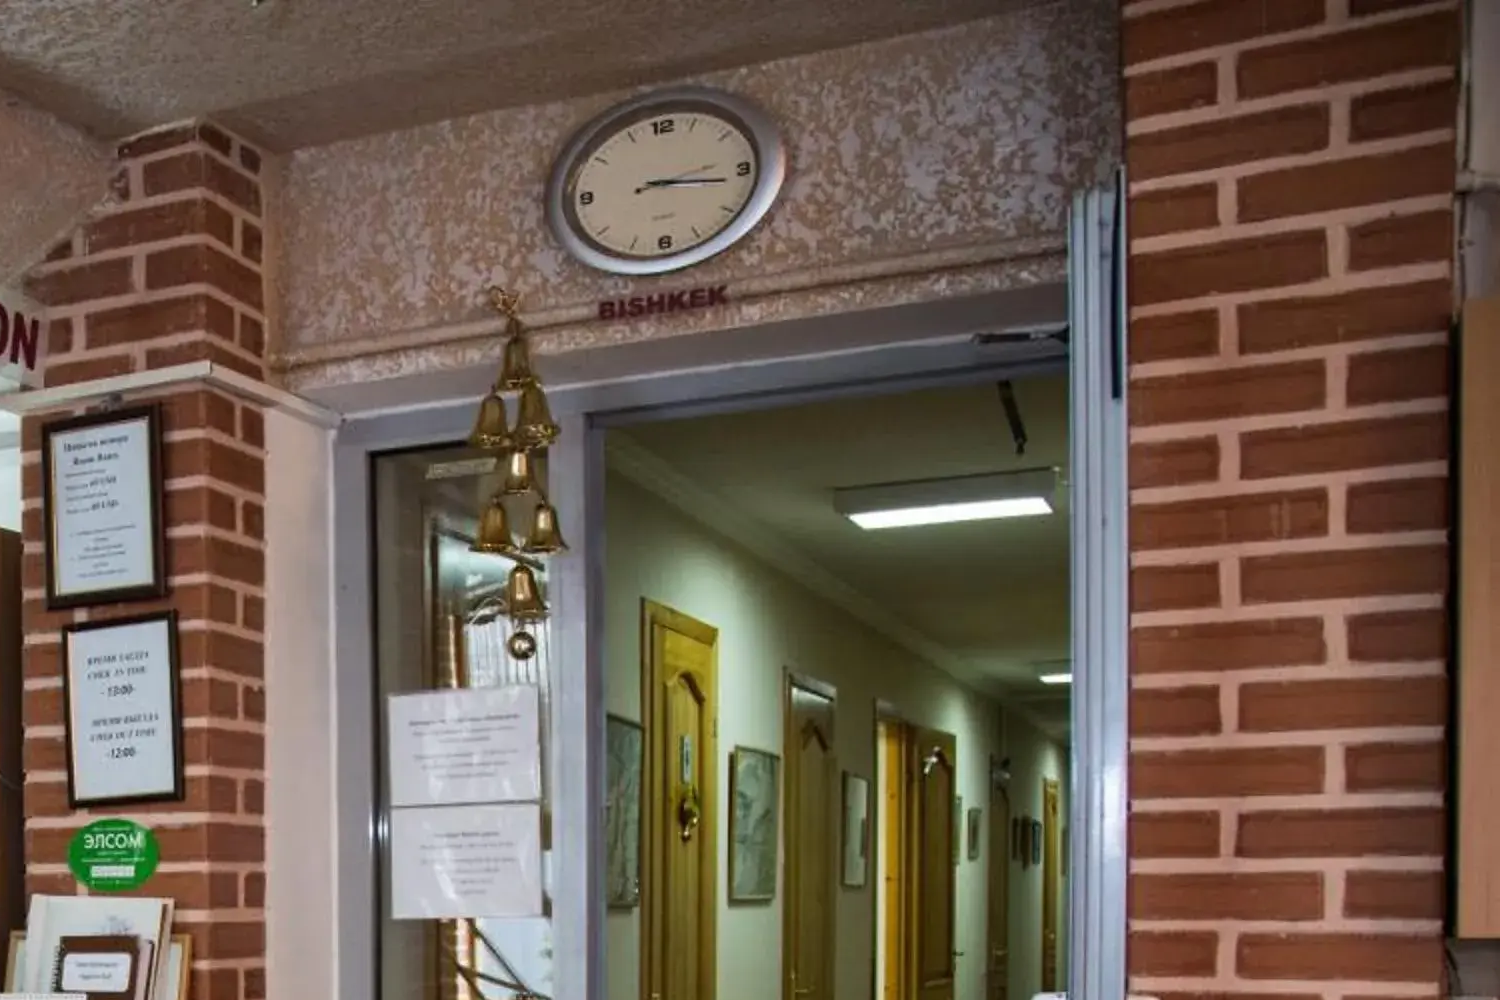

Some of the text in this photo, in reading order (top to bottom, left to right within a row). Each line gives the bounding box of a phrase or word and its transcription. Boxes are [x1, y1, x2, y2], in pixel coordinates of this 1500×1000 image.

[650, 119, 675, 136] 12
[736, 161, 750, 177] 3
[579, 191, 594, 205] 9
[658, 235, 672, 249] 6
[598, 285, 728, 320] BISHKEK
[83, 831, 142, 849] ЭЛСОМ
